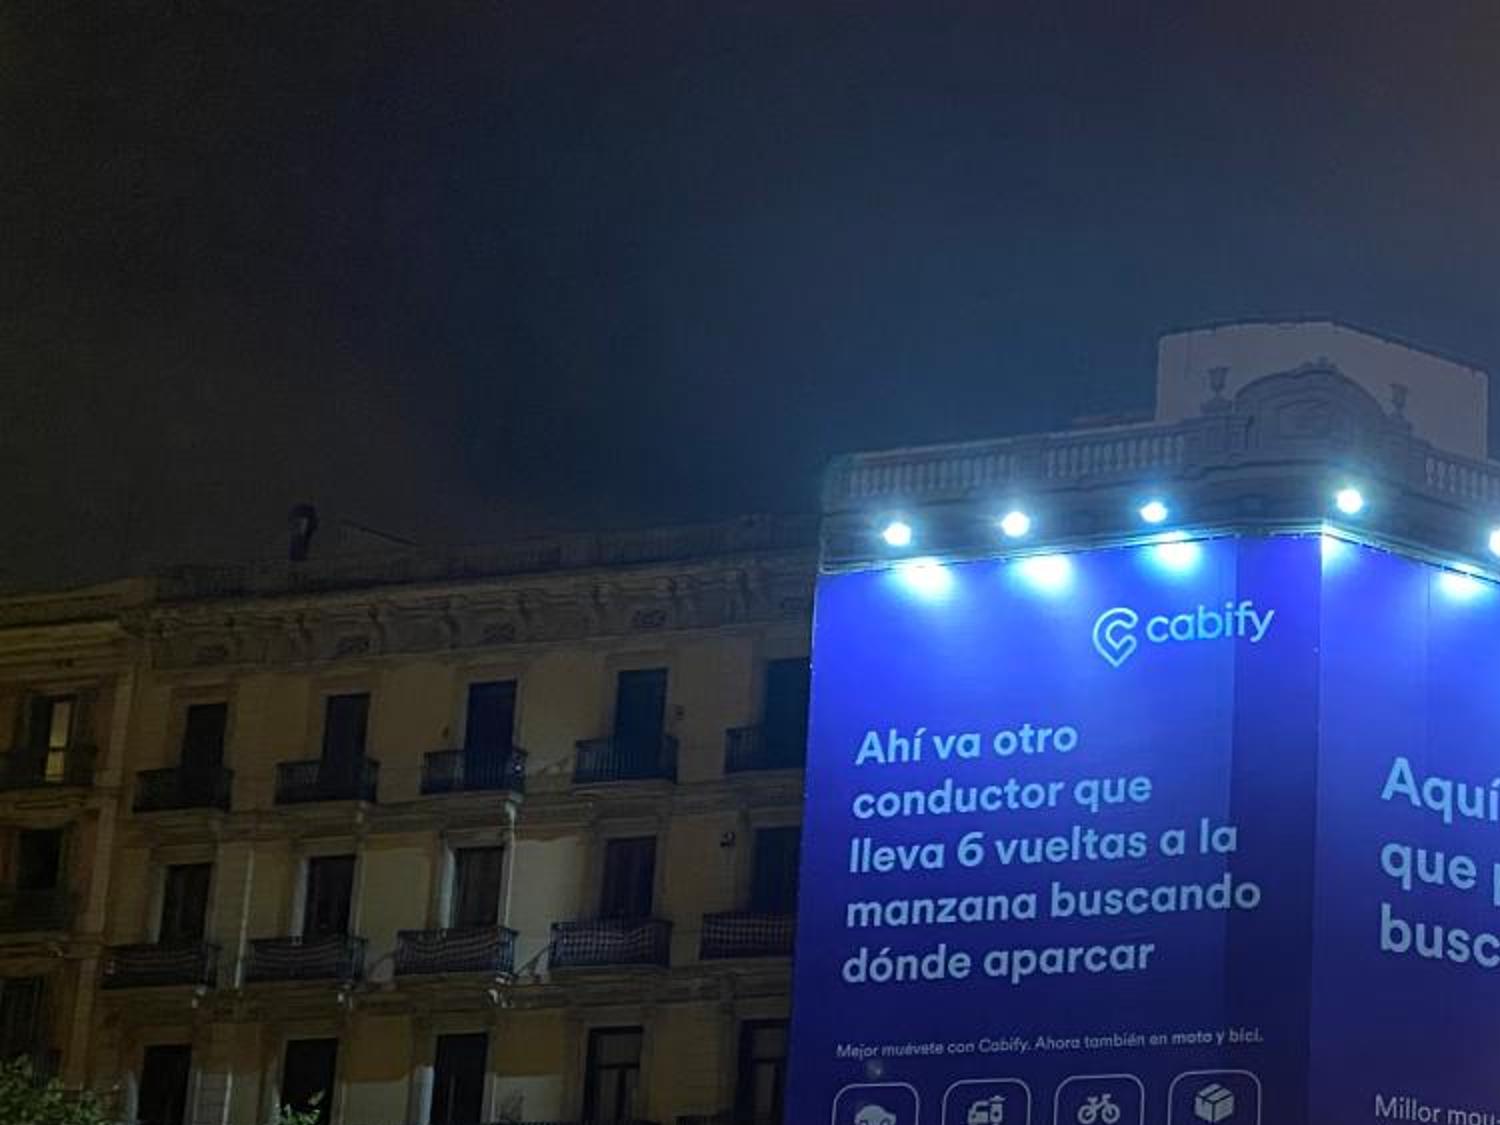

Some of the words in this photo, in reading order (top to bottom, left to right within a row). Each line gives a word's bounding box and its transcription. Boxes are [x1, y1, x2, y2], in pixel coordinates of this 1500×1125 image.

[1146, 601, 1276, 643] cabify
[855, 727, 928, 766] Ahí
[932, 732, 981, 760] va
[993, 722, 1078, 757] otro
[853, 777, 1063, 819] conductor
[1074, 775, 1153, 817] que
[849, 837, 945, 873] lleva
[957, 831, 985, 867] 6
[994, 825, 1147, 866] vueltas
[1159, 830, 1185, 857] a
[1200, 817, 1238, 853] la
[1381, 843, 1477, 891] que
[846, 892, 1037, 929] manzana
[1050, 873, 1261, 918] buscando
[842, 943, 971, 984] dónde
[983, 942, 1155, 984] aparcar
[836, 1042, 879, 1060] Mejor
[881, 1041, 944, 1057] muévete
[946, 1043, 974, 1055] con
[978, 1036, 1031, 1055] Cabify.
[1034, 1035, 1081, 1050] Ahora
[1084, 1031, 1146, 1048] también
[1149, 1034, 1168, 1046] en
[1171, 1031, 1214, 1045] moto
[1215, 1032, 1226, 1046] y
[1229, 1029, 1265, 1043] bici.
[1375, 1094, 1440, 1123] Millor
